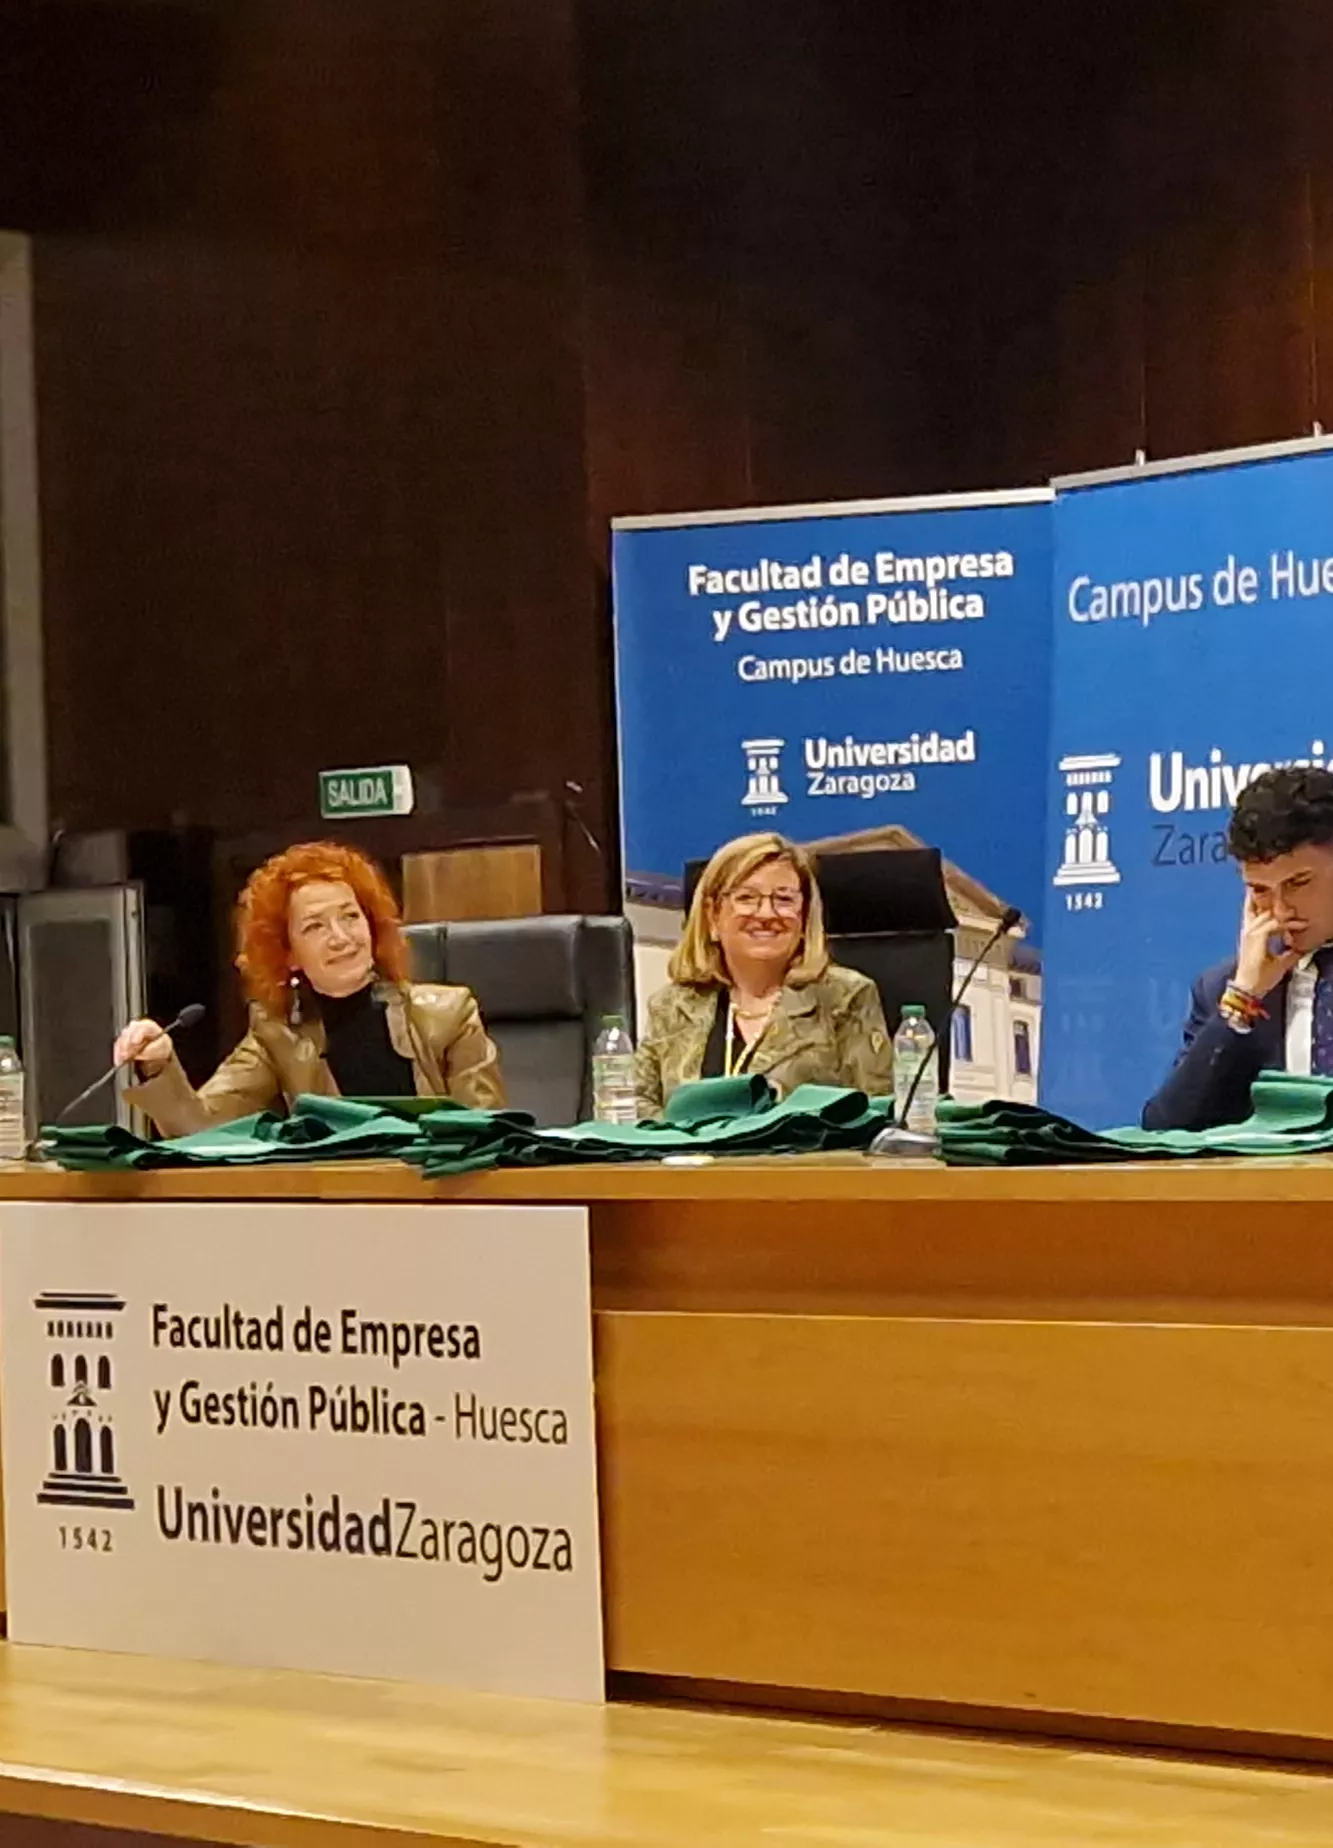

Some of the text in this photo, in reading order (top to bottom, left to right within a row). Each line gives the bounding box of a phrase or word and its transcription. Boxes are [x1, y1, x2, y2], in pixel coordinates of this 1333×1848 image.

[689, 551, 1014, 596] Facultad de Empresa
[1068, 573, 1203, 627] Campus
[1212, 554, 1256, 606] de
[712, 587, 984, 642] y Gestión Pública
[738, 646, 964, 684] Campus de Huesca
[805, 730, 976, 769] Universidad
[327, 777, 389, 807] SALIDA
[806, 770, 916, 800] Zaragoza
[1152, 824, 1228, 867] Zara
[152, 1303, 481, 1368] Facultad de Empresa
[153, 1389, 172, 1434] y
[179, 1380, 299, 1429] Gestión
[309, 1384, 426, 1437] Pública
[455, 1393, 569, 1445] Huesca
[59, 1527, 113, 1552] 1542
